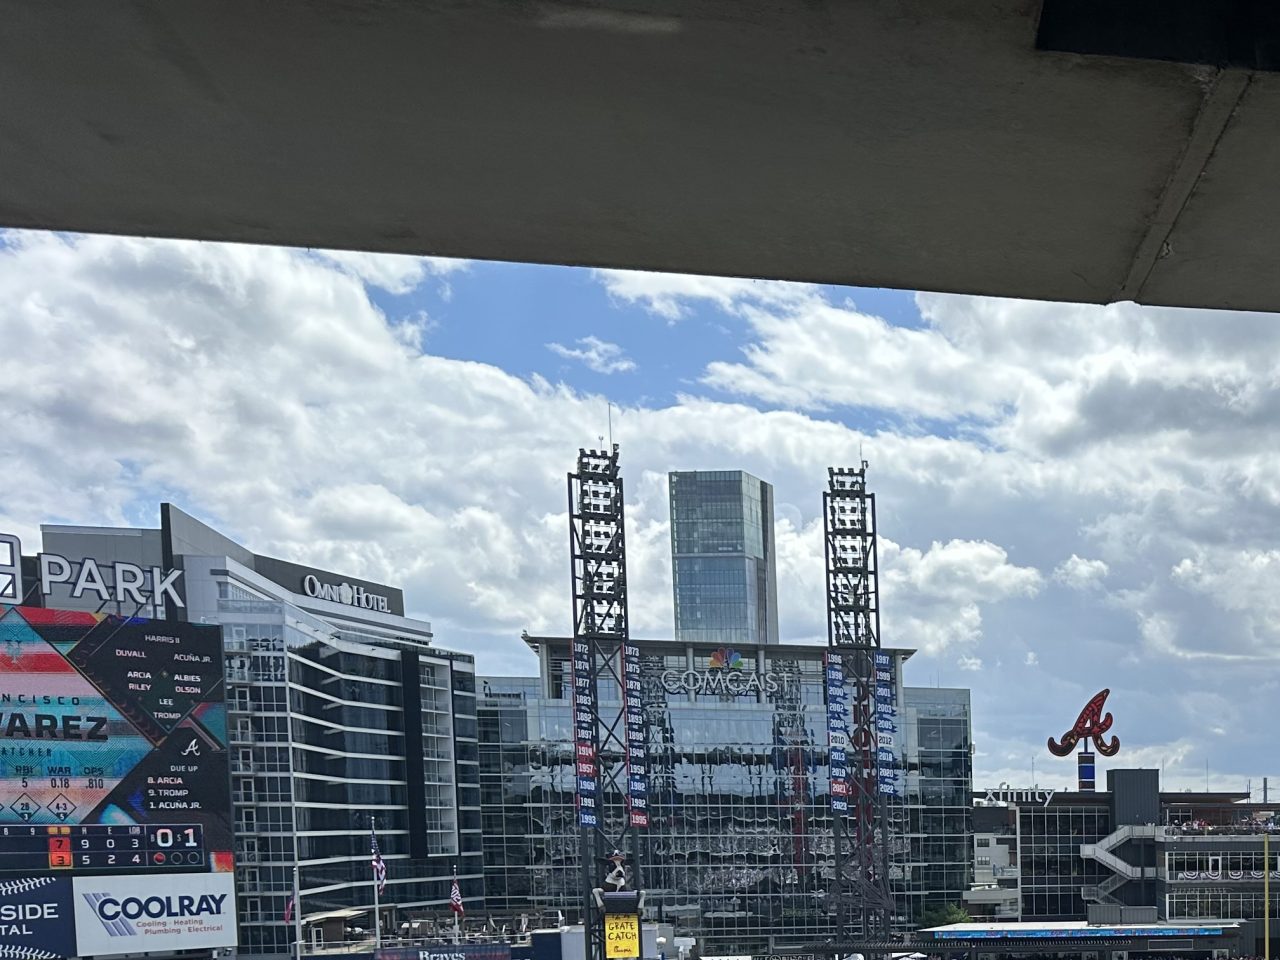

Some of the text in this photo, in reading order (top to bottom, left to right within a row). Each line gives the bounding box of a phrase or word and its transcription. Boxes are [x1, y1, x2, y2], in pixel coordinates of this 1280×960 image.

[40, 553, 185, 608] PARK
[304, 575, 391, 613] OMNI HOTEL
[145, 634, 174, 644] HARRIS
[115, 649, 146, 659] DUVALL
[174, 652, 200, 663] ACUÑA
[876, 655, 890, 664] 1997
[127, 671, 151, 679] ARCIA
[174, 674, 201, 682] ALBIES
[661, 670, 792, 692] COMCAST
[128, 683, 151, 691] RILEY
[175, 686, 201, 694] OLSON
[829, 687, 844, 696] 2000
[877, 687, 891, 697] 2001
[159, 698, 173, 706] LEE
[830, 703, 844, 713] 2002
[878, 704, 892, 713] 2003
[153, 712, 181, 720] TROMP
[831, 735, 844, 745] 2010
[879, 736, 892, 745] 2012
[579, 746, 593, 756] 1914
[831, 751, 845, 761] 2013
[16, 766, 71, 775] RBI WAR
[579, 763, 593, 773] 1957
[832, 768, 846, 777] 2019
[880, 768, 893, 778] 2020
[22, 777, 104, 788] 5 0.18 .810
[631, 781, 645, 791] 1982
[158, 789, 188, 797] TROMP
[832, 783, 846, 793] 2021
[880, 784, 894, 794] 2022
[984, 782, 1056, 807] xfinity
[158, 800, 188, 809] ACUÑA
[581, 797, 595, 807] 1991
[631, 798, 646, 808] 1992
[833, 801, 847, 810] 2023
[581, 814, 596, 824] 1993
[632, 815, 647, 825] 1995
[157, 828, 197, 847] 0 1
[56, 839, 139, 849] 7 9 0 3
[82, 855, 140, 864] 5 2 4
[0, 903, 59, 920] SIDE
[98, 894, 228, 920] COOLRAY
[136, 921, 167, 929] Cooling
[609, 922, 635, 930] GRATE
[144, 925, 223, 936] Plumbing Electrical
[608, 932, 637, 941] CATCH
